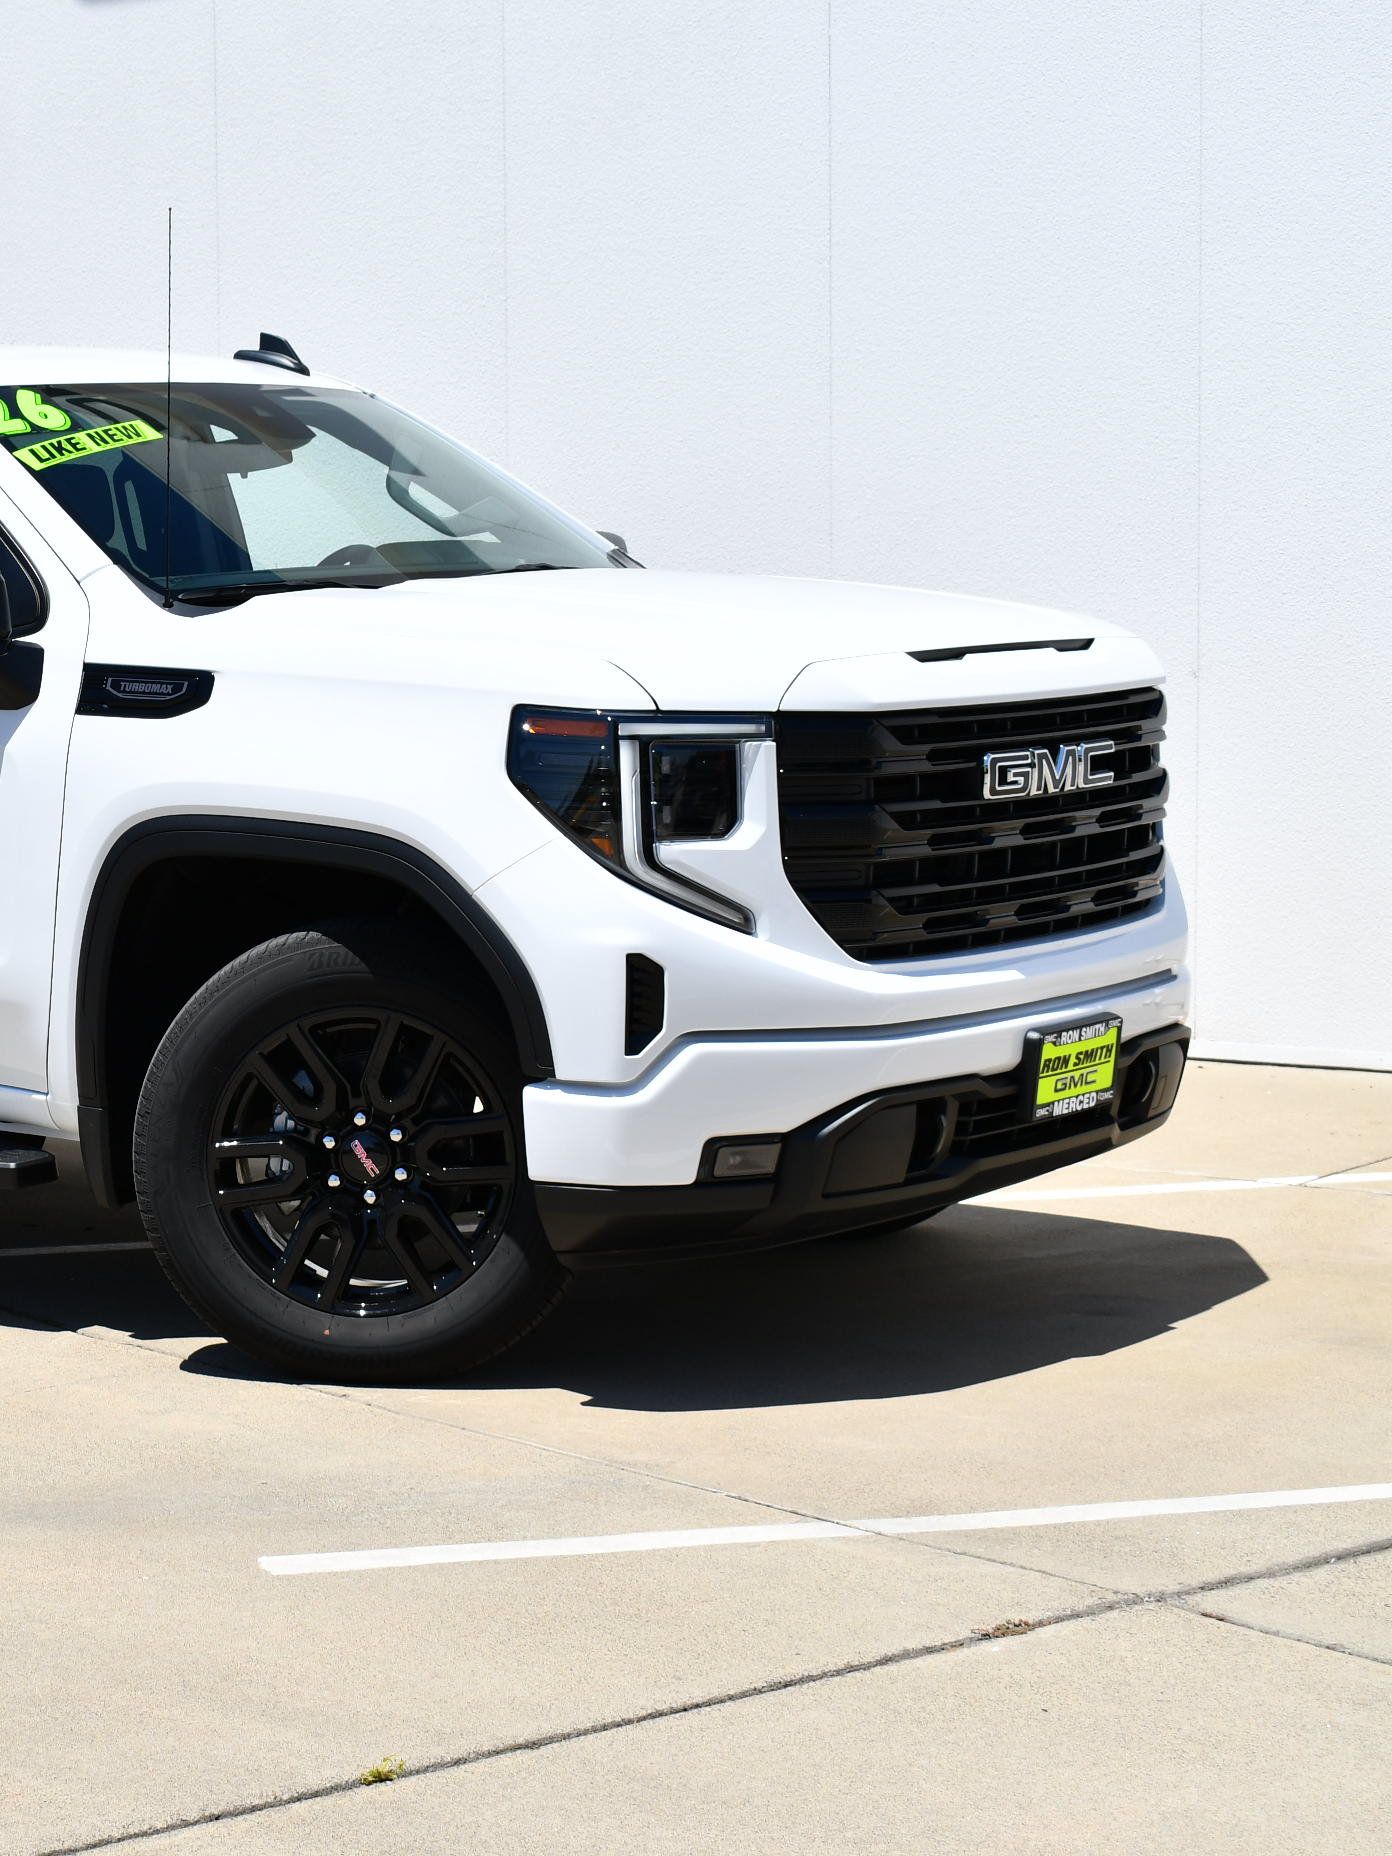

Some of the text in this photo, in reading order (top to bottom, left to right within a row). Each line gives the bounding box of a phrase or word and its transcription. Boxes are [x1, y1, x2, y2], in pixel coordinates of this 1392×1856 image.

[28, 423, 144, 464] LIKE NEW
[120, 682, 174, 694] TURBOMAX
[983, 739, 1115, 800] GMC
[1061, 1029, 1080, 1045] RON
[1081, 1022, 1105, 1040] SMITH
[1040, 1043, 1114, 1074] RON SMITH
[1054, 1069, 1097, 1092] GMC
[1053, 1092, 1096, 1117] MERCED
[350, 1139, 380, 1178] GMC
